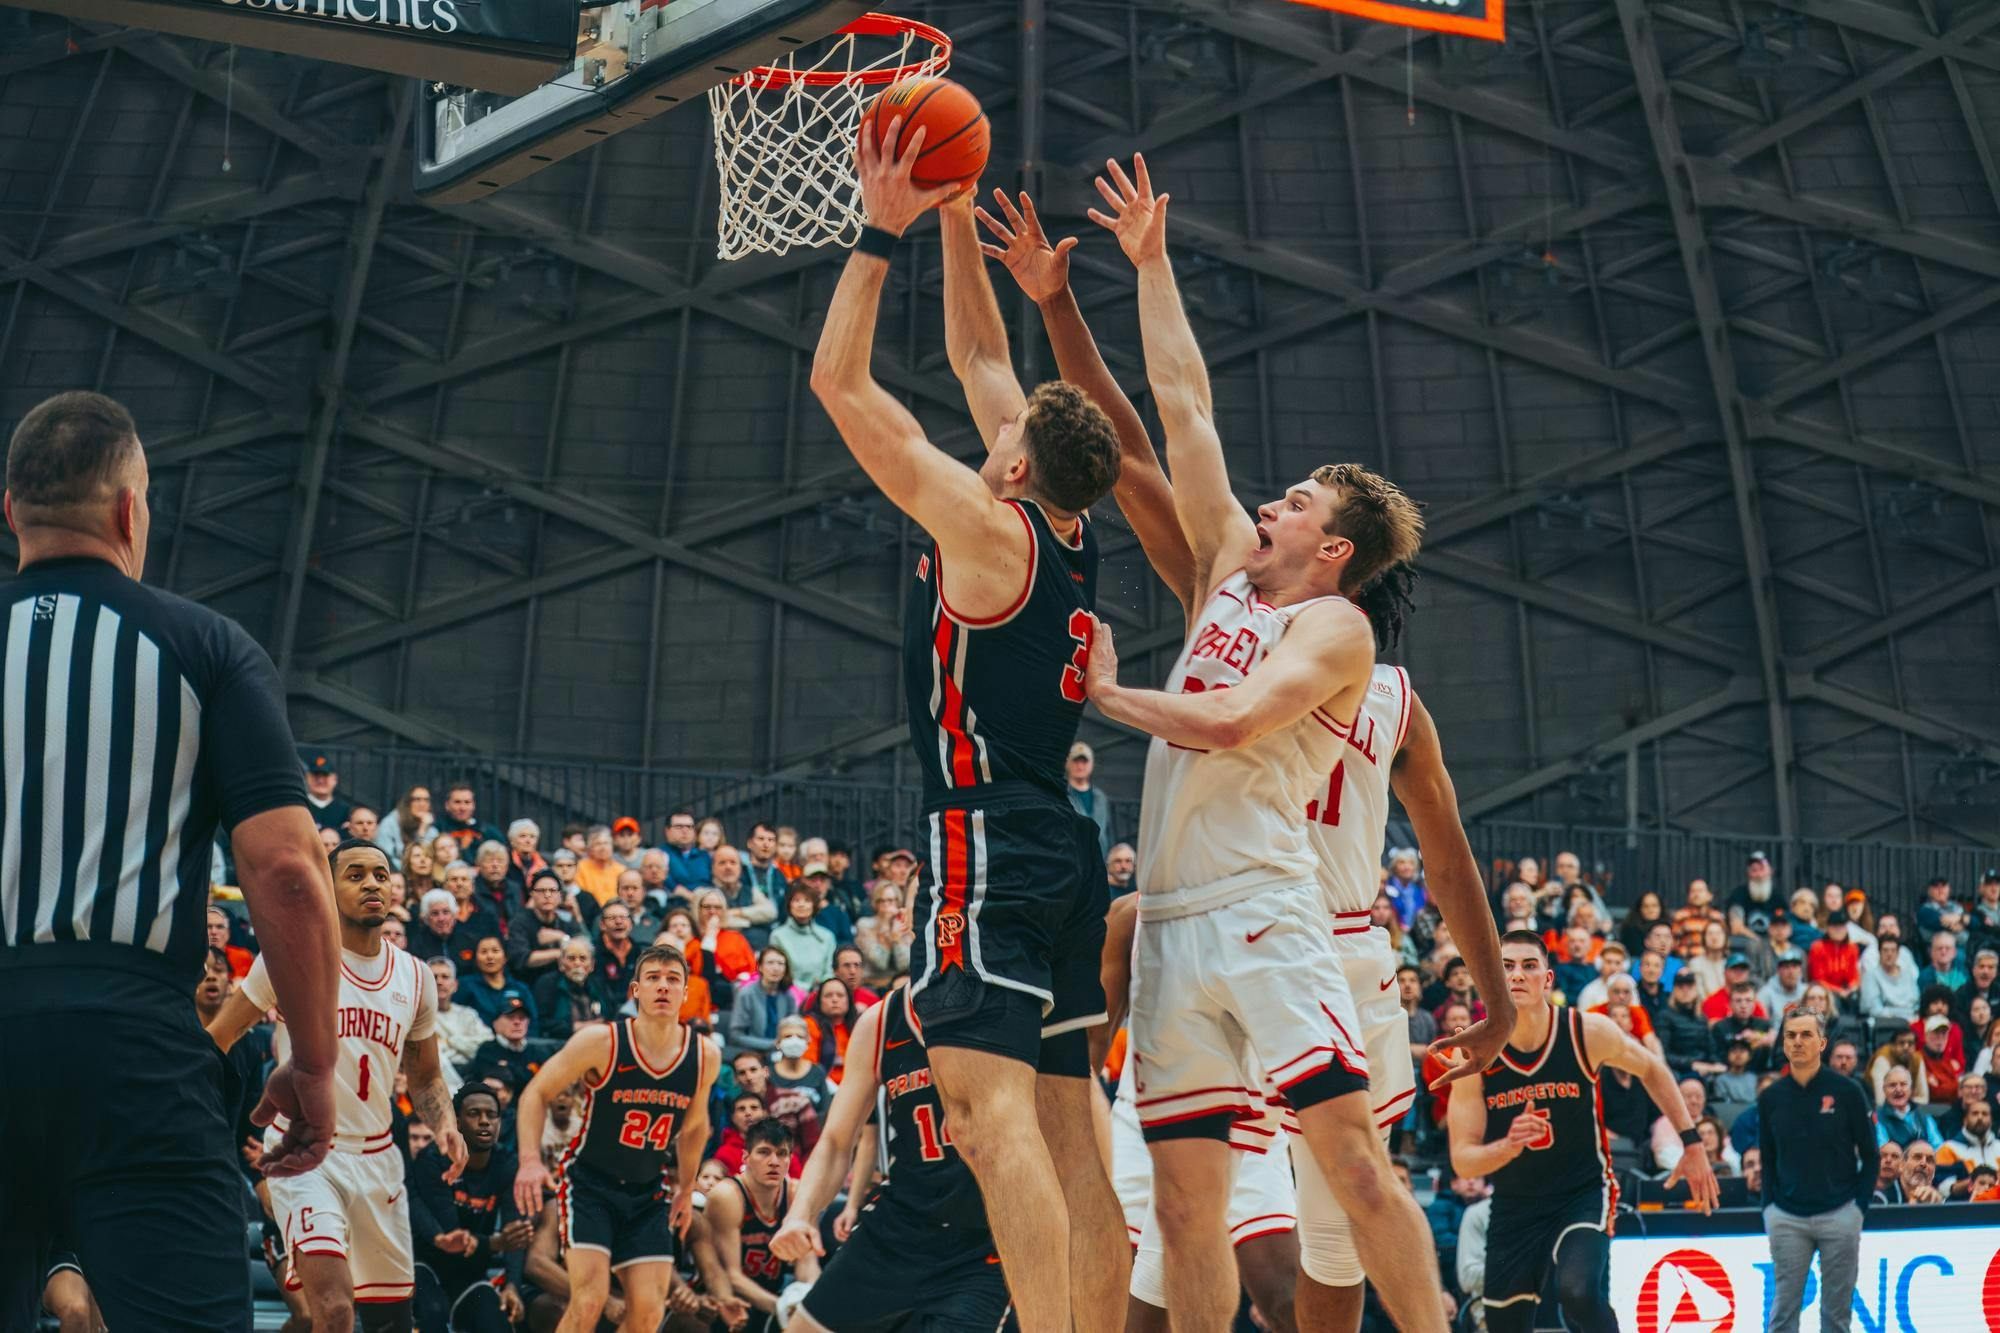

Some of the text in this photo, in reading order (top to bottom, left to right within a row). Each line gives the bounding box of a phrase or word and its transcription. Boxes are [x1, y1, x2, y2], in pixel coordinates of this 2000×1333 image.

[1306, 759, 1345, 827] 1
[937, 912, 966, 948] P
[357, 1054, 370, 1102] 1
[1487, 1082, 1580, 1110] PRINCETON
[619, 1109, 675, 1150] 24
[301, 1207, 314, 1233] C
[742, 1249, 782, 1279] 54
